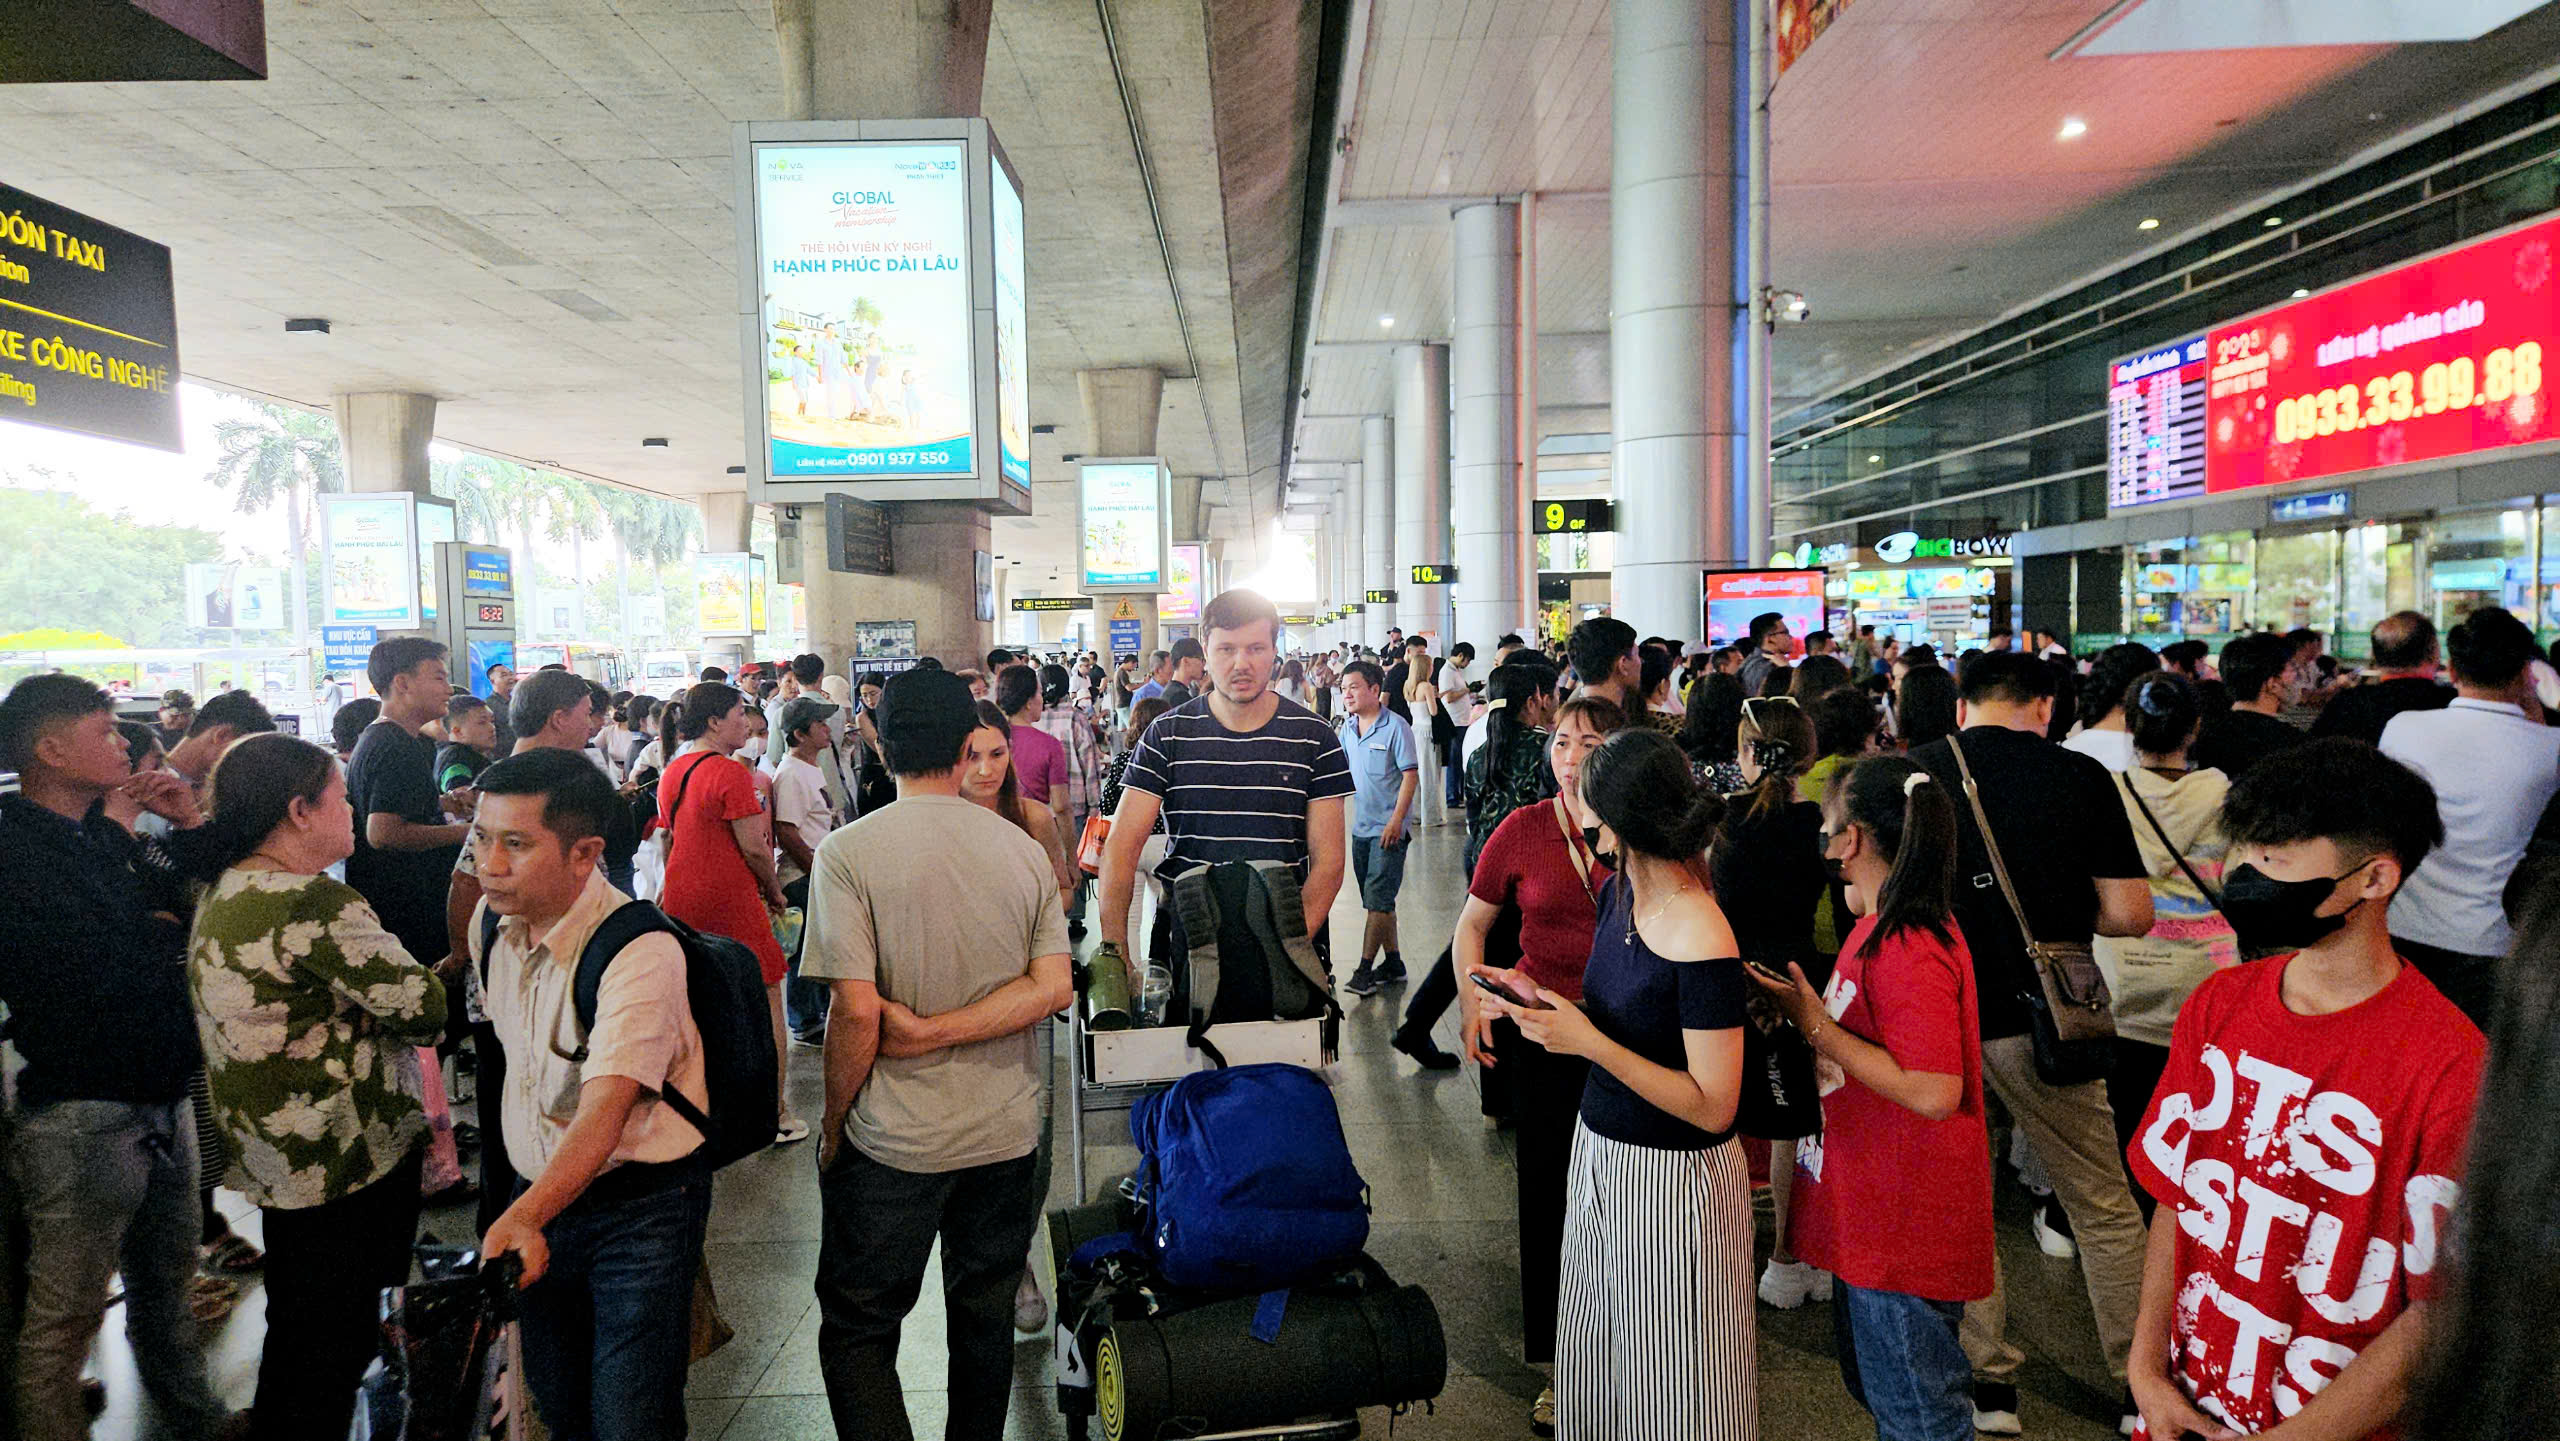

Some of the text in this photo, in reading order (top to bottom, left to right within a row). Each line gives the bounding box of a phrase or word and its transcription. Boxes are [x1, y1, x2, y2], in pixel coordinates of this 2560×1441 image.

[832, 191, 895, 205] GLOBAL
[51, 229, 105, 272] TAXI
[773, 254, 959, 277] HẠNH PHÚC DÀI LÂU
[31, 336, 103, 379] CÔNG
[2275, 341, 2542, 444] 0933.33.99.88
[848, 453, 884, 465] 0901
[888, 452, 916, 465] 937
[919, 452, 949, 464] 550
[1545, 503, 1586, 530] 9 GF
[1412, 566, 1433, 582] 10
[1367, 591, 1380, 602] 11
